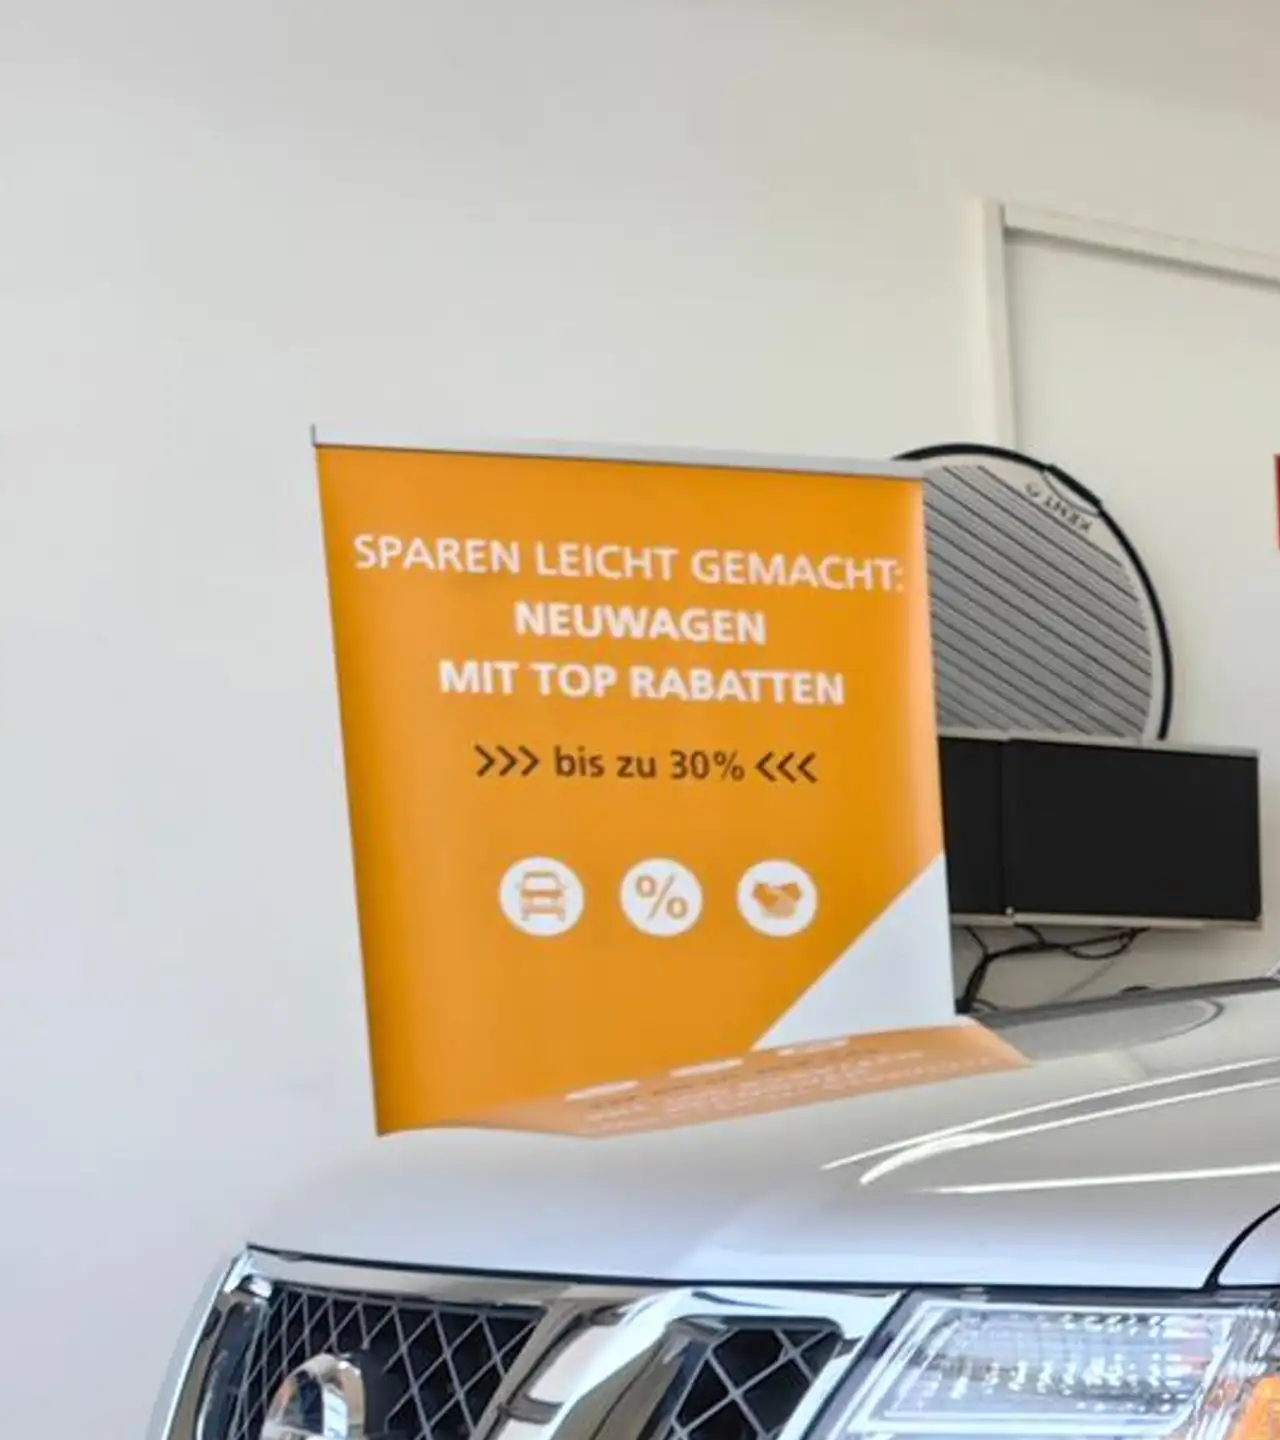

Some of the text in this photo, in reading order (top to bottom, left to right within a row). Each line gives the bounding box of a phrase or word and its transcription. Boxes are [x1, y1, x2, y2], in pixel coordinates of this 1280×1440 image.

[354, 534, 904, 593] SPAREN LEICHT GEMACHT:
[515, 601, 767, 645] NEUWAGEN
[440, 660, 845, 706] MIT TOP RABATTEN
[554, 746, 745, 782] bis zu 30%
